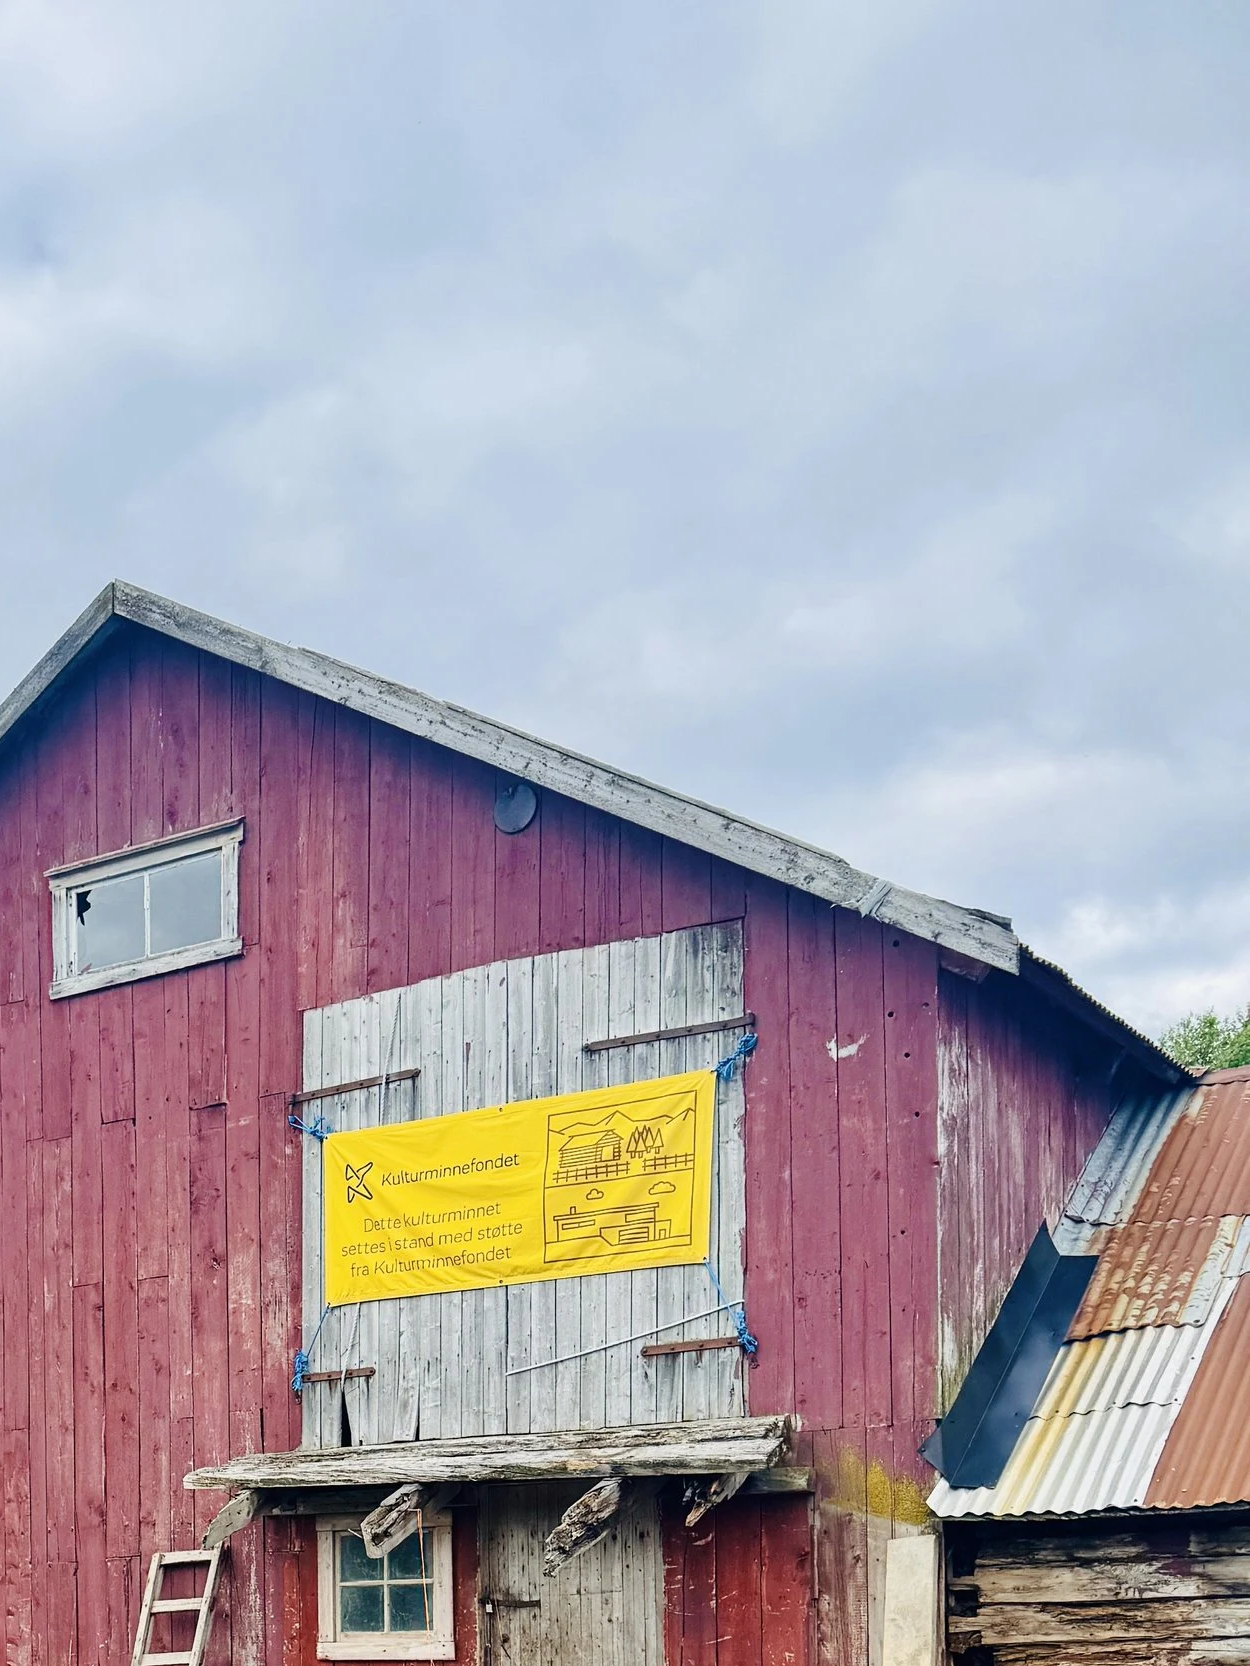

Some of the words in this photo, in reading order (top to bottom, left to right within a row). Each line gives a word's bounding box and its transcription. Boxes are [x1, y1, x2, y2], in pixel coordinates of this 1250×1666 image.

[381, 1153, 520, 1187] Kulturminnefondet
[363, 1217, 402, 1233] Dette
[403, 1202, 501, 1228] kulturminnet
[341, 1242, 387, 1257] settes
[388, 1237, 393, 1252] i
[395, 1232, 435, 1251] stand
[438, 1227, 473, 1246] med
[477, 1222, 523, 1241] støtte
[351, 1262, 370, 1278] fra
[374, 1246, 512, 1275] Kulturminnefondet
